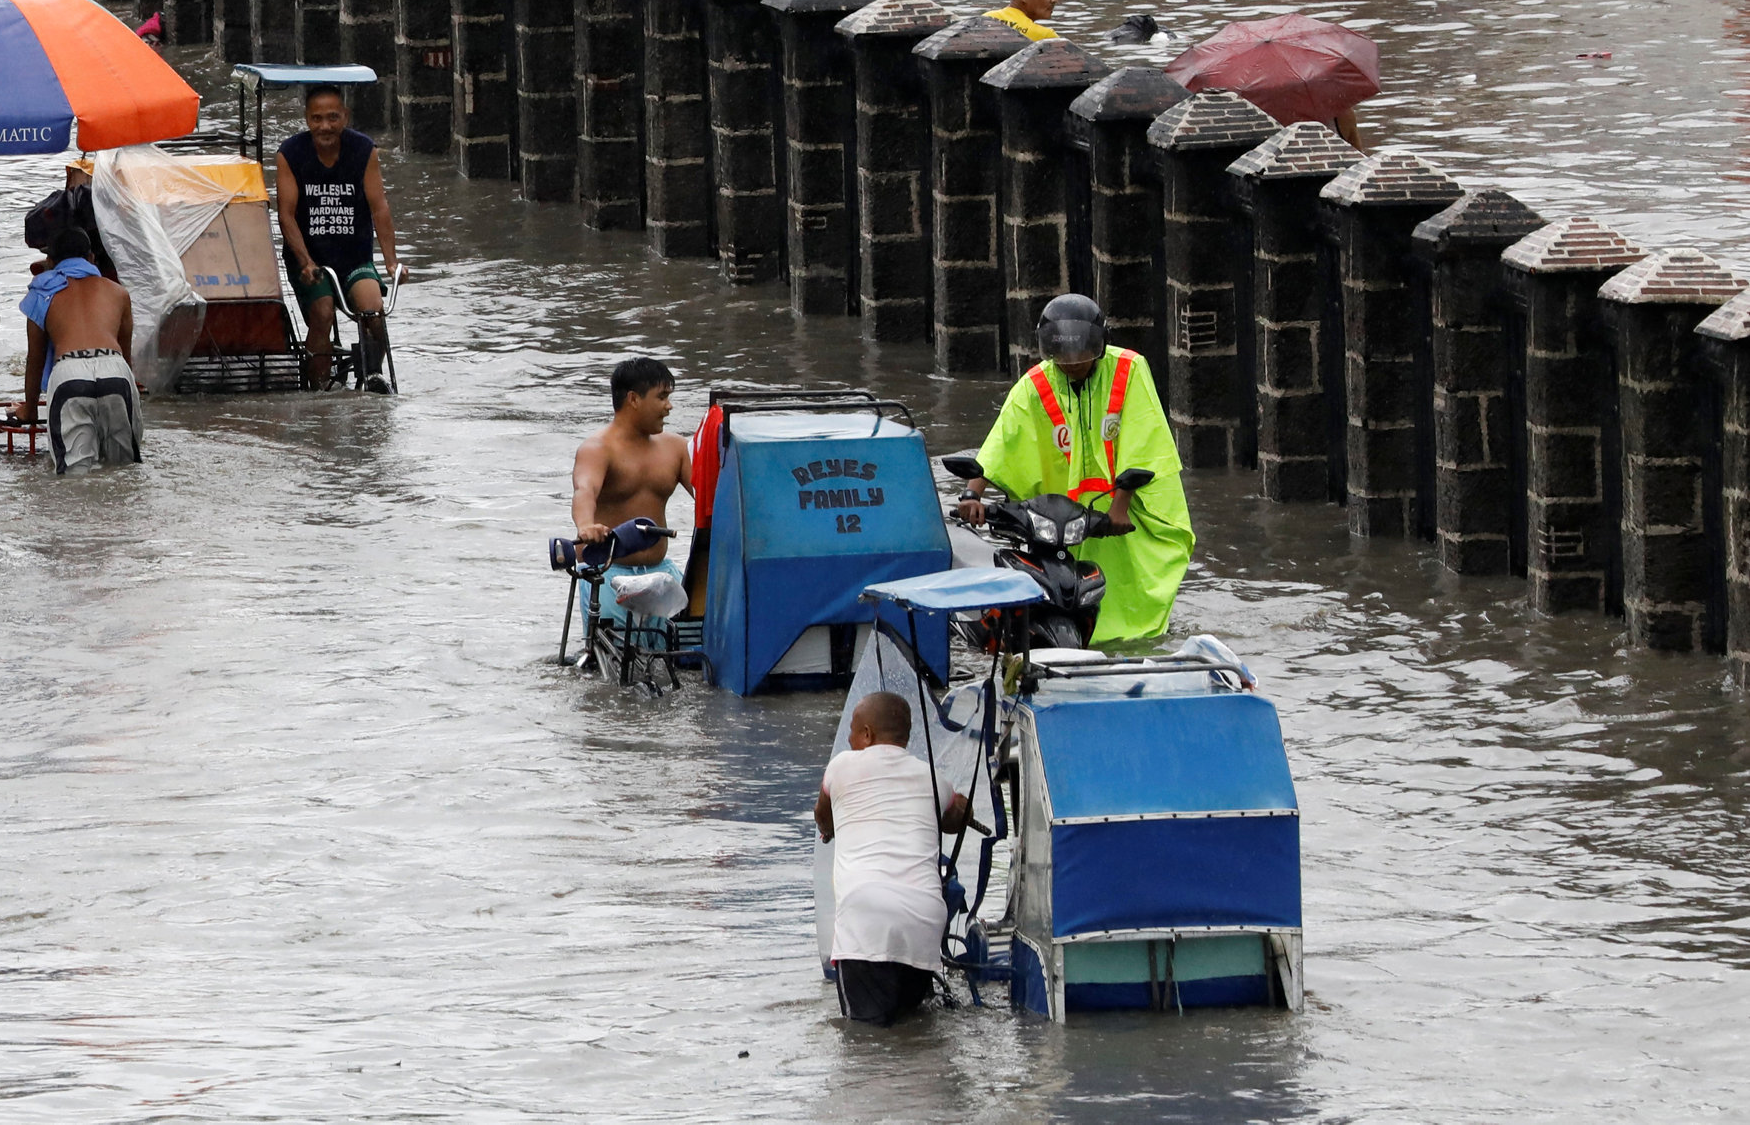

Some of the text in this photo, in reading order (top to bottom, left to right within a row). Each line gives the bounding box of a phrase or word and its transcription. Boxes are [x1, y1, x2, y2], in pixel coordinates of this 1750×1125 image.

[320, 196, 342, 206] ENT.
[309, 206, 355, 216] HARDWARE
[309, 215, 355, 226] 846-3637
[309, 225, 355, 236] 846-6393
[791, 458, 878, 487] REYES
[836, 514, 862, 534] 12
